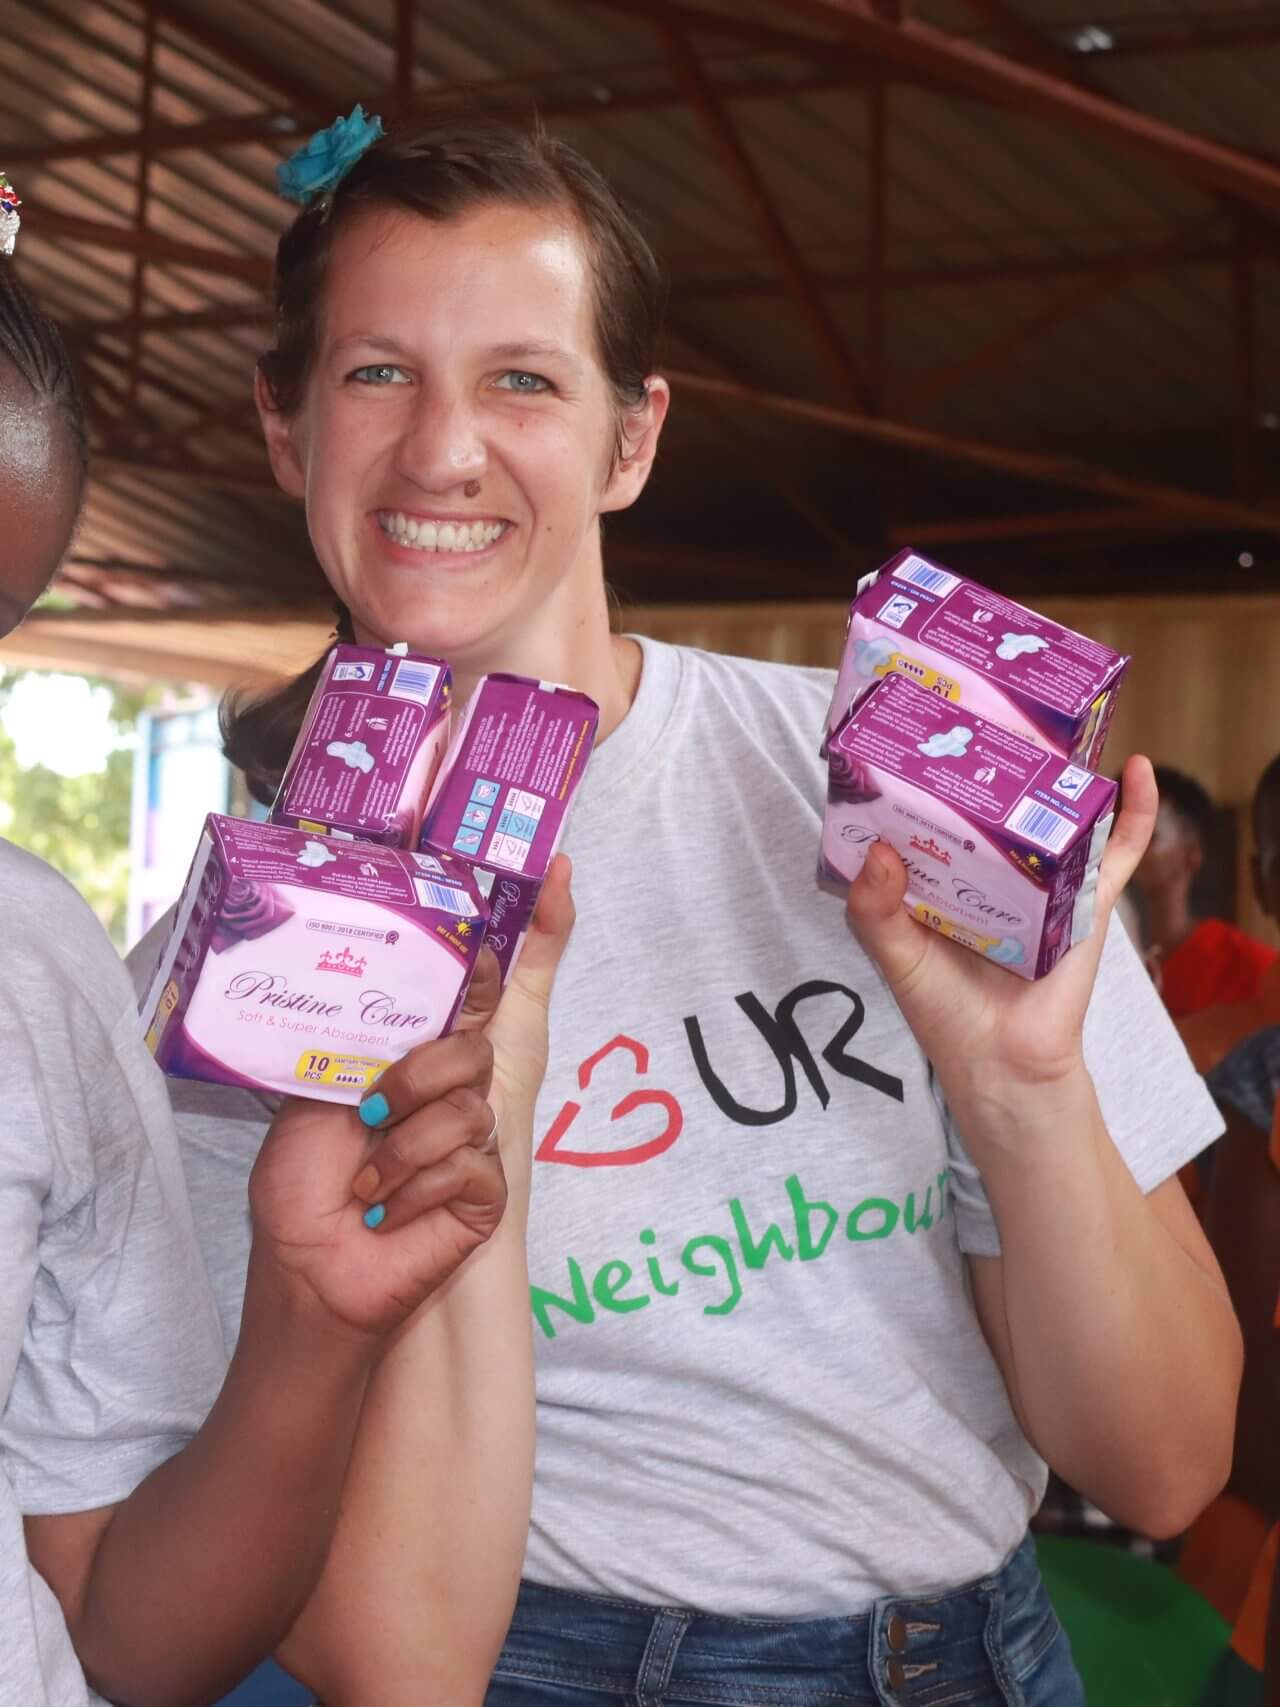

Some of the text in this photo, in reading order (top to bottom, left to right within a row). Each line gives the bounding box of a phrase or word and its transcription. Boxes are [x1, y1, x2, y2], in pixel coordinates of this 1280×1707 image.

[923, 910, 942, 926] 10
[952, 878, 1022, 925] Care
[224, 970, 429, 1029] Pristine Care
[237, 1009, 390, 1046] Soft & Super Absorbent
[309, 1055, 330, 1072] 10
[683, 978, 904, 1127] UR
[304, 1070, 322, 1081] PCS
[529, 1173, 953, 1340] Neighbour
